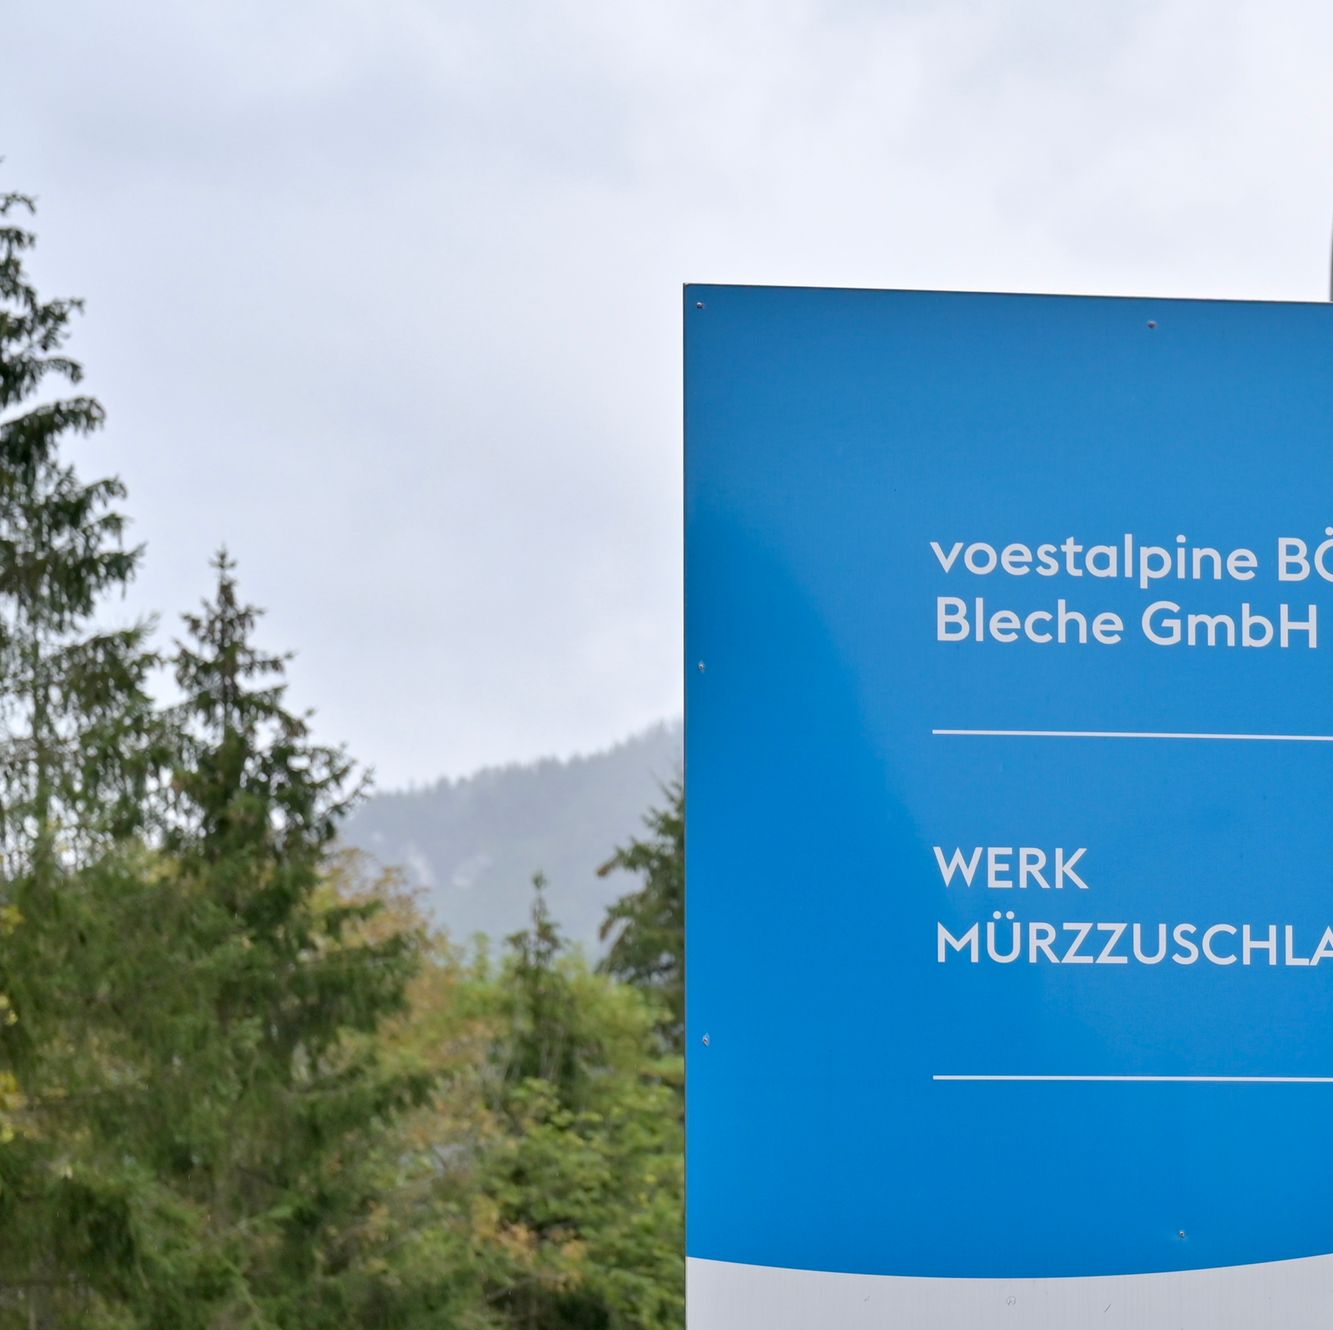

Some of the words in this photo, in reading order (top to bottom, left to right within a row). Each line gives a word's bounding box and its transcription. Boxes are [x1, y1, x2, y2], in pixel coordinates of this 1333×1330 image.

[929, 533, 1259, 590] voestalpine
[936, 596, 1124, 645] Bleche
[1141, 600, 1319, 649] GmbH
[933, 846, 1089, 890] WERK
